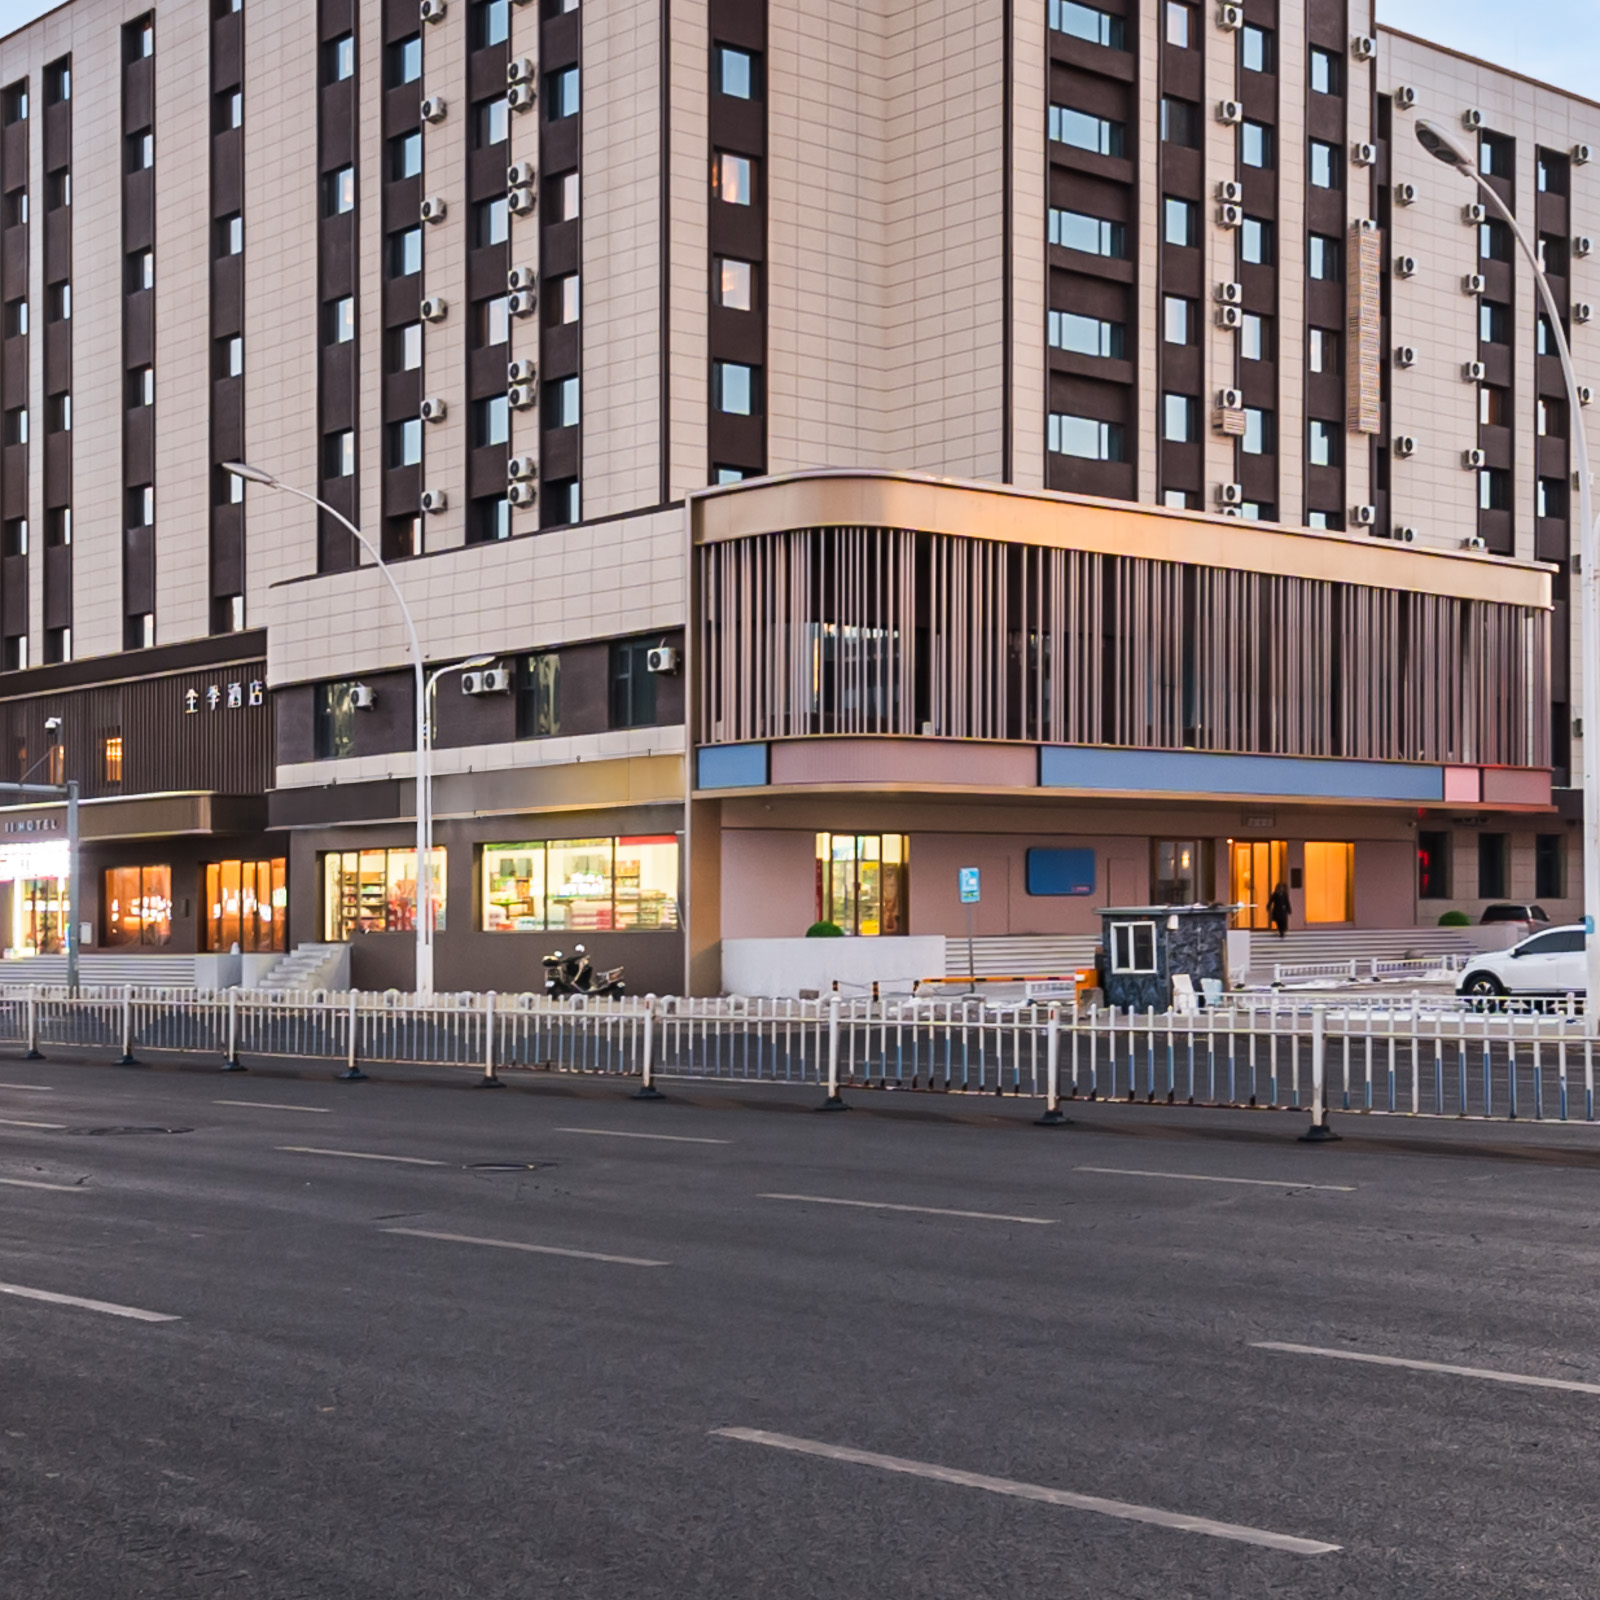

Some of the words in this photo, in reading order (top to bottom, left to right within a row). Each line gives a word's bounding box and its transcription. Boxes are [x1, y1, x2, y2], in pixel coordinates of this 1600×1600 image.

[185, 680, 263, 714] 全季酒店
[18, 818, 58, 832] HOTEL
